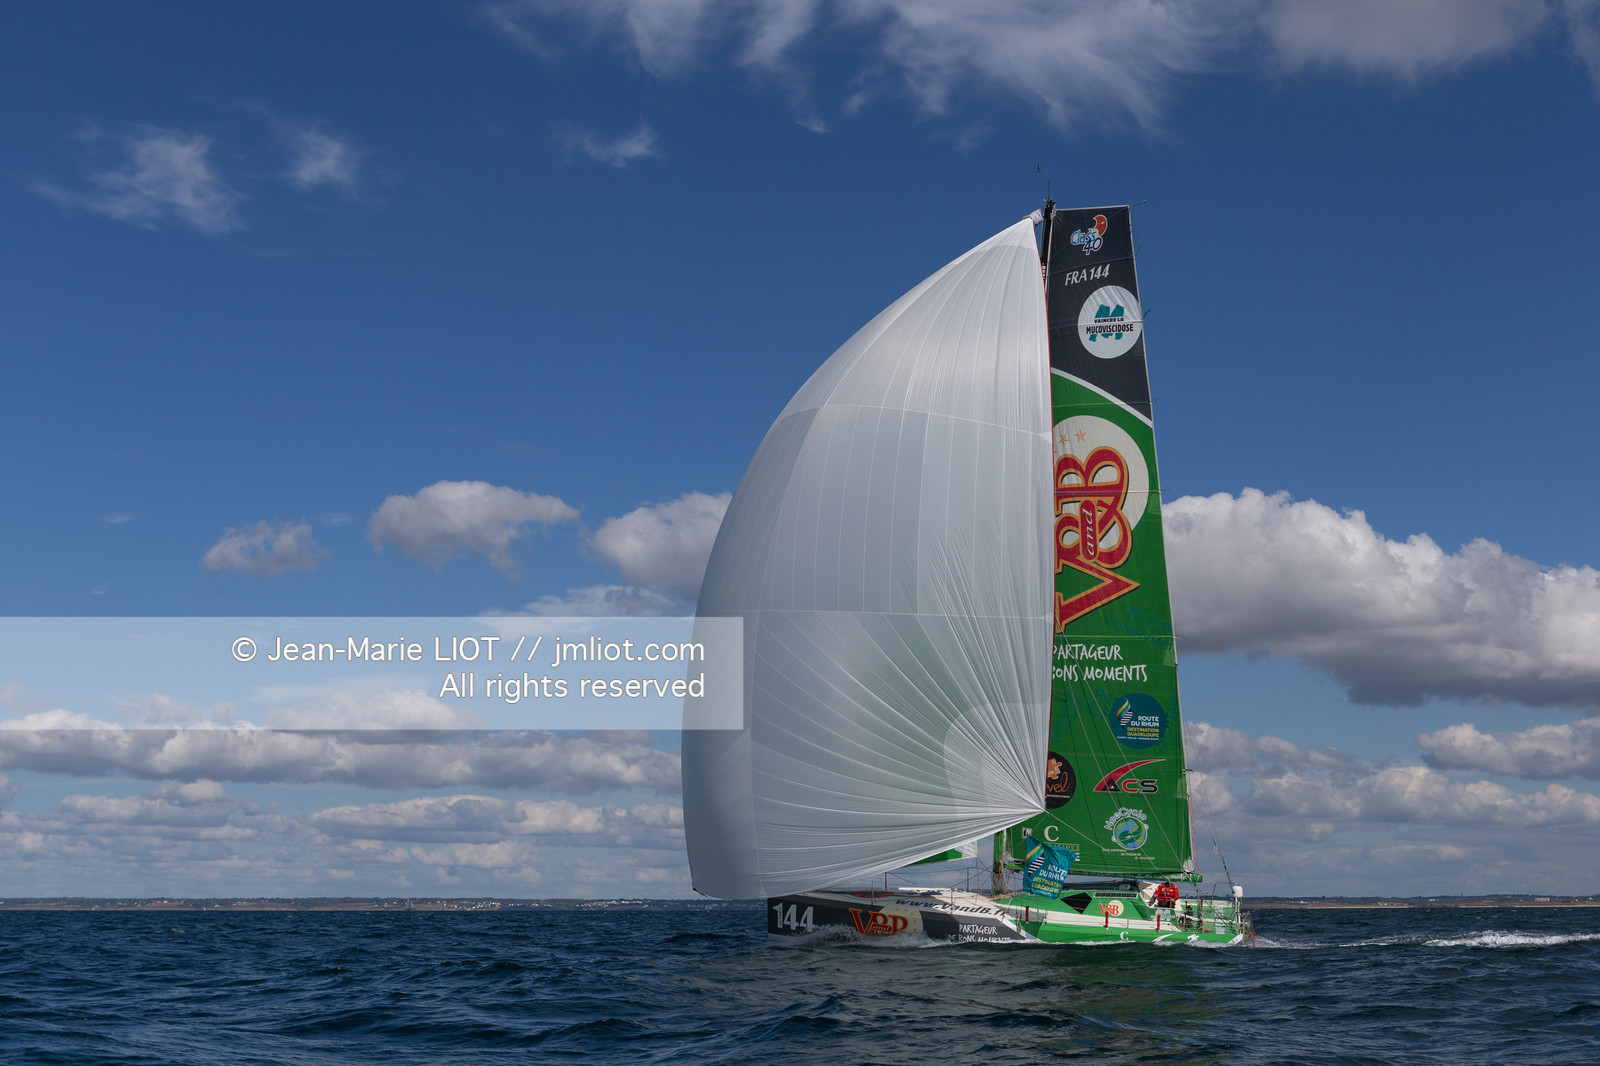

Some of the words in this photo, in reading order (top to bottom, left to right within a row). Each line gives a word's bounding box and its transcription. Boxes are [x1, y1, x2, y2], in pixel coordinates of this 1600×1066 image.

[1071, 229, 1097, 245] Class
[1083, 236, 1103, 255] 40
[1065, 269, 1087, 286] FRA
[1089, 264, 1111, 281] 144
[1086, 323, 1134, 335] MUCOVISCIDOSE
[1081, 509, 1096, 557] and
[1083, 664, 1148, 682] MOMENTS
[1093, 778, 1158, 793] ACS
[1104, 807, 1148, 831] NeoCycle
[773, 902, 816, 933] 144
[872, 924, 890, 932] and
[959, 923, 998, 935] PARTAGEUR
